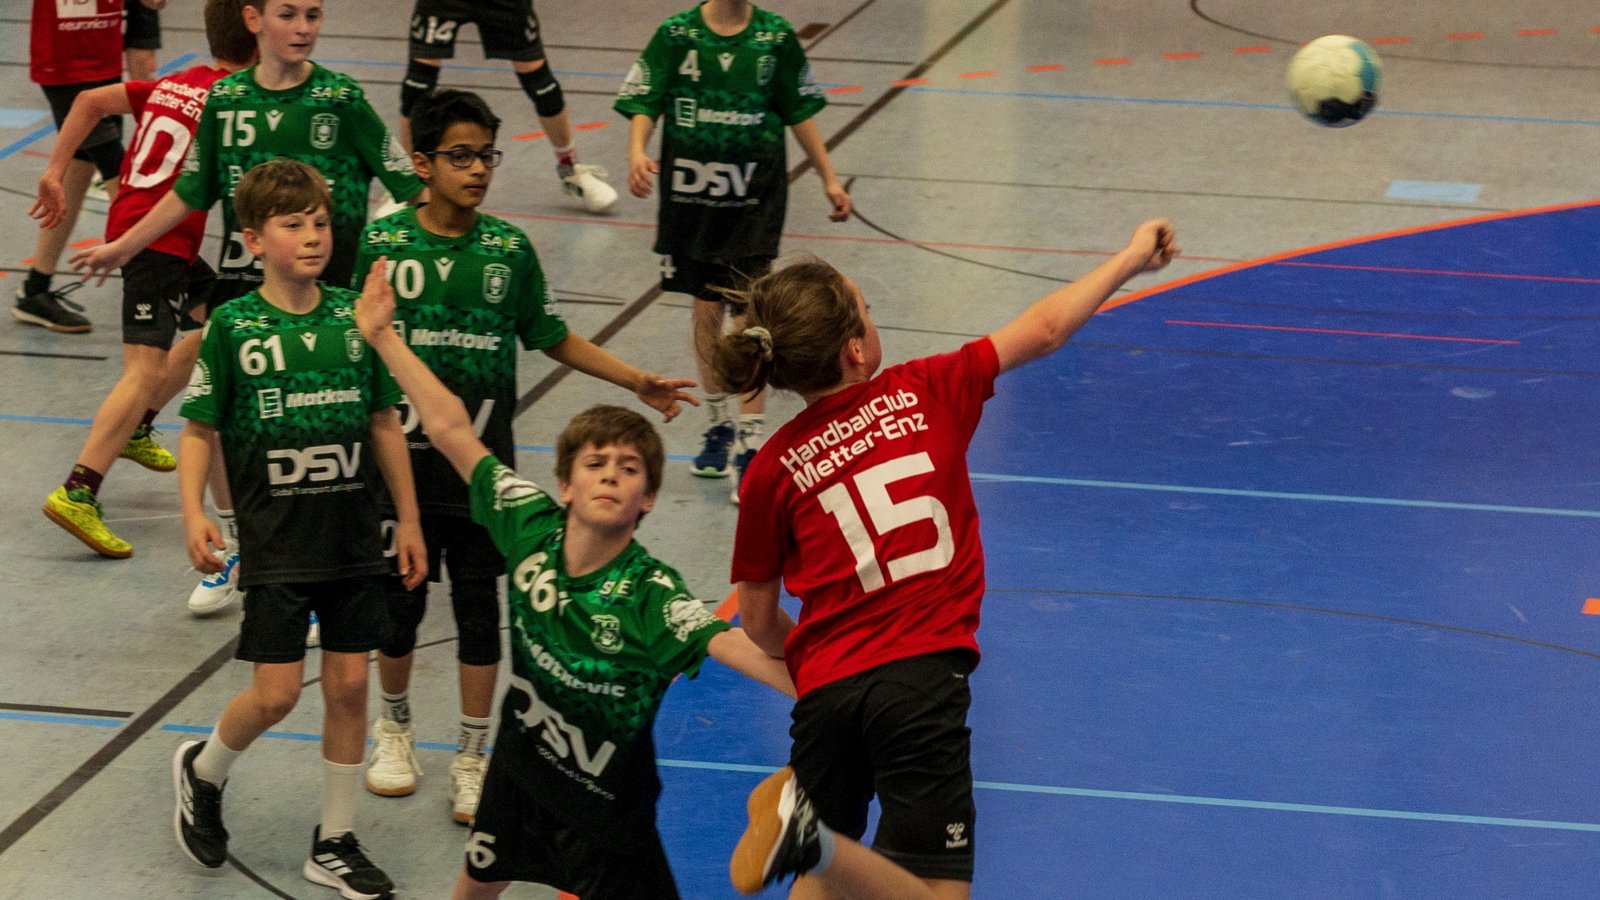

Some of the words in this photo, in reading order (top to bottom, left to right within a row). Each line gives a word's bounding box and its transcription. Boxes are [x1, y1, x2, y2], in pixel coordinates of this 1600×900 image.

[679, 49, 701, 82] 4
[216, 110, 257, 147] 75
[671, 158, 759, 197] DSV
[239, 334, 286, 376] 61
[779, 389, 919, 474] HandballClub
[793, 412, 929, 494] Metter-Enz
[266, 441, 362, 485] DSV
[816, 451, 955, 594] 15
[513, 551, 557, 613] 66
